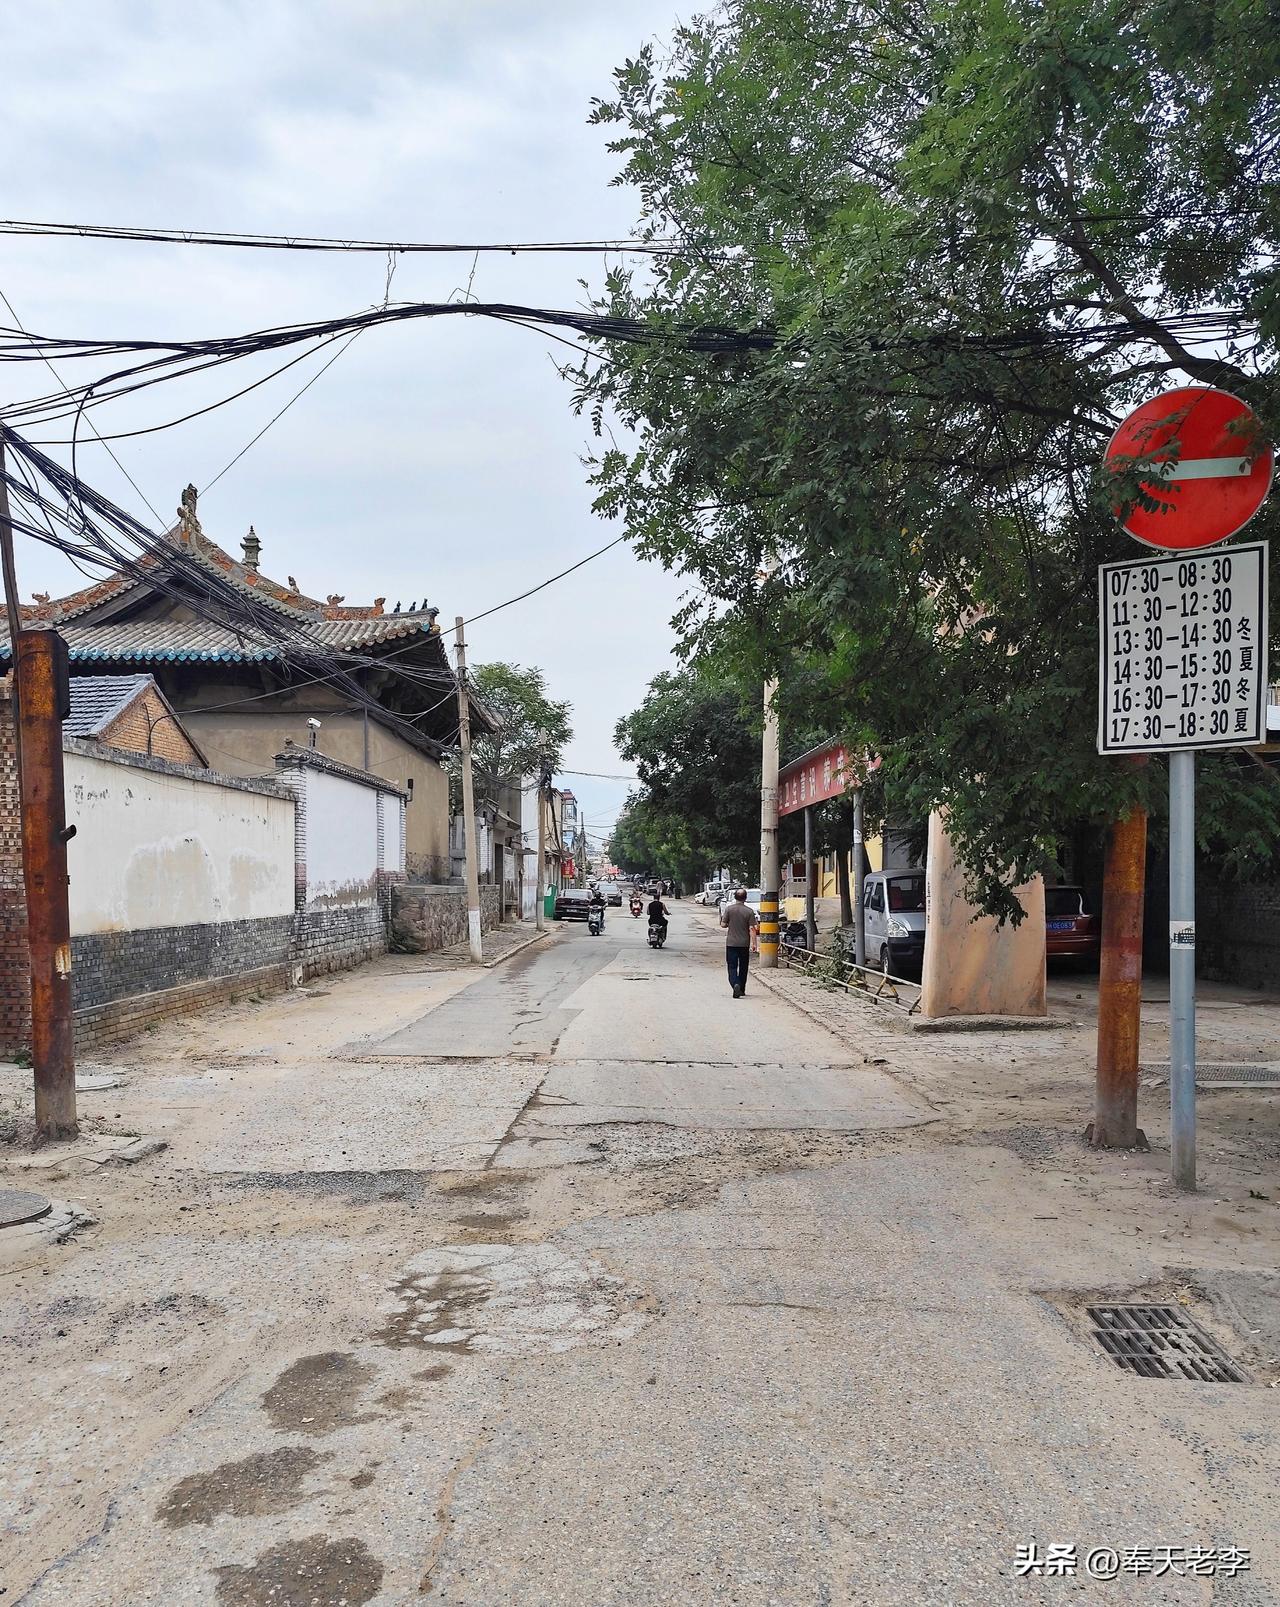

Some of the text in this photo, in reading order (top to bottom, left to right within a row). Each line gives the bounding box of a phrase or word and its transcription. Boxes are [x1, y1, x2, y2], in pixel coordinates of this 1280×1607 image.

[1237, 616, 1252, 641] 冬
[1239, 645, 1254, 672] 夏
[1236, 677, 1251, 701] 冬
[1234, 707, 1249, 733] 夏
